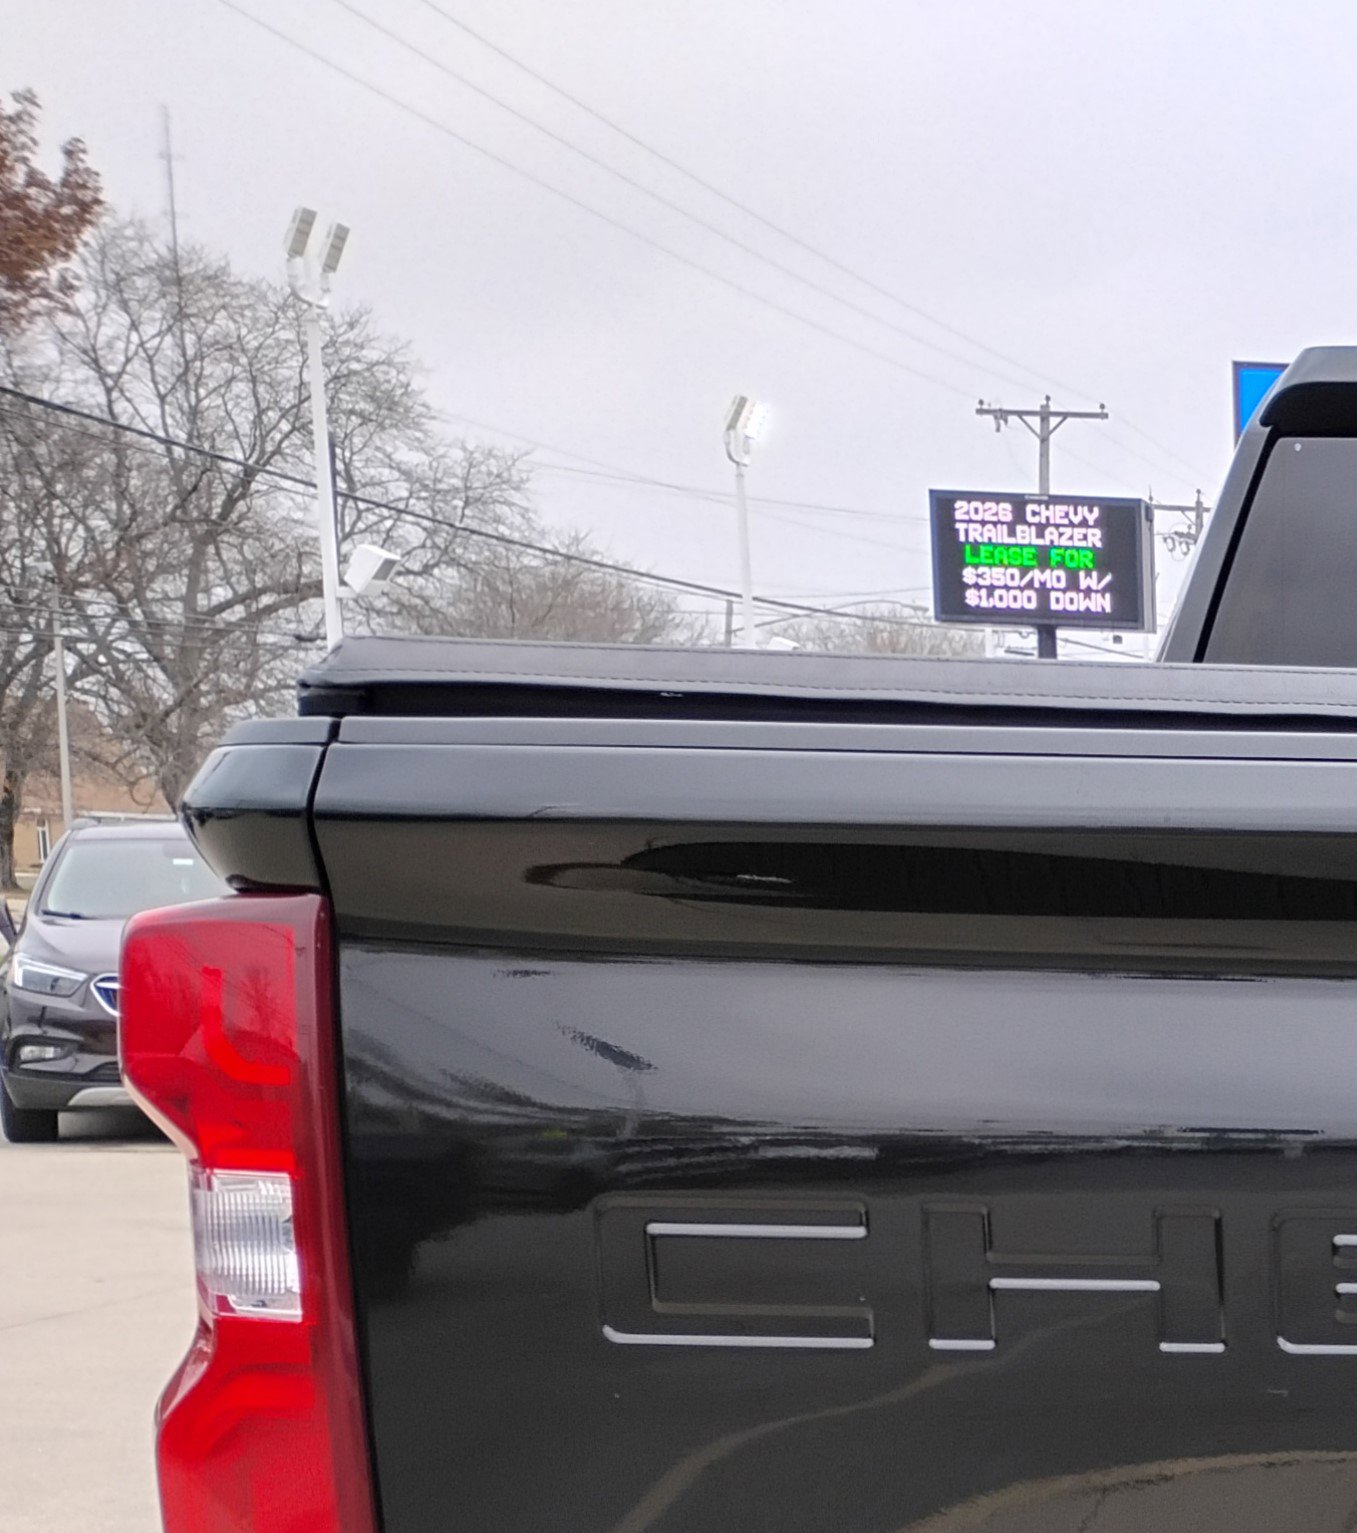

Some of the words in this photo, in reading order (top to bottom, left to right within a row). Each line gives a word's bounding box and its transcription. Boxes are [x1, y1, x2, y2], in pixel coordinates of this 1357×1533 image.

[954, 500, 1012, 522] 2026
[1026, 504, 1099, 525] CHEVY
[955, 522, 1102, 547] TRAILBLAZER
[965, 544, 1037, 566] LEASE
[1050, 547, 1094, 569] FOR
[962, 566, 1066, 588] $350/MO
[1080, 572, 1112, 590] W/
[1050, 592, 1111, 613] DOWN
